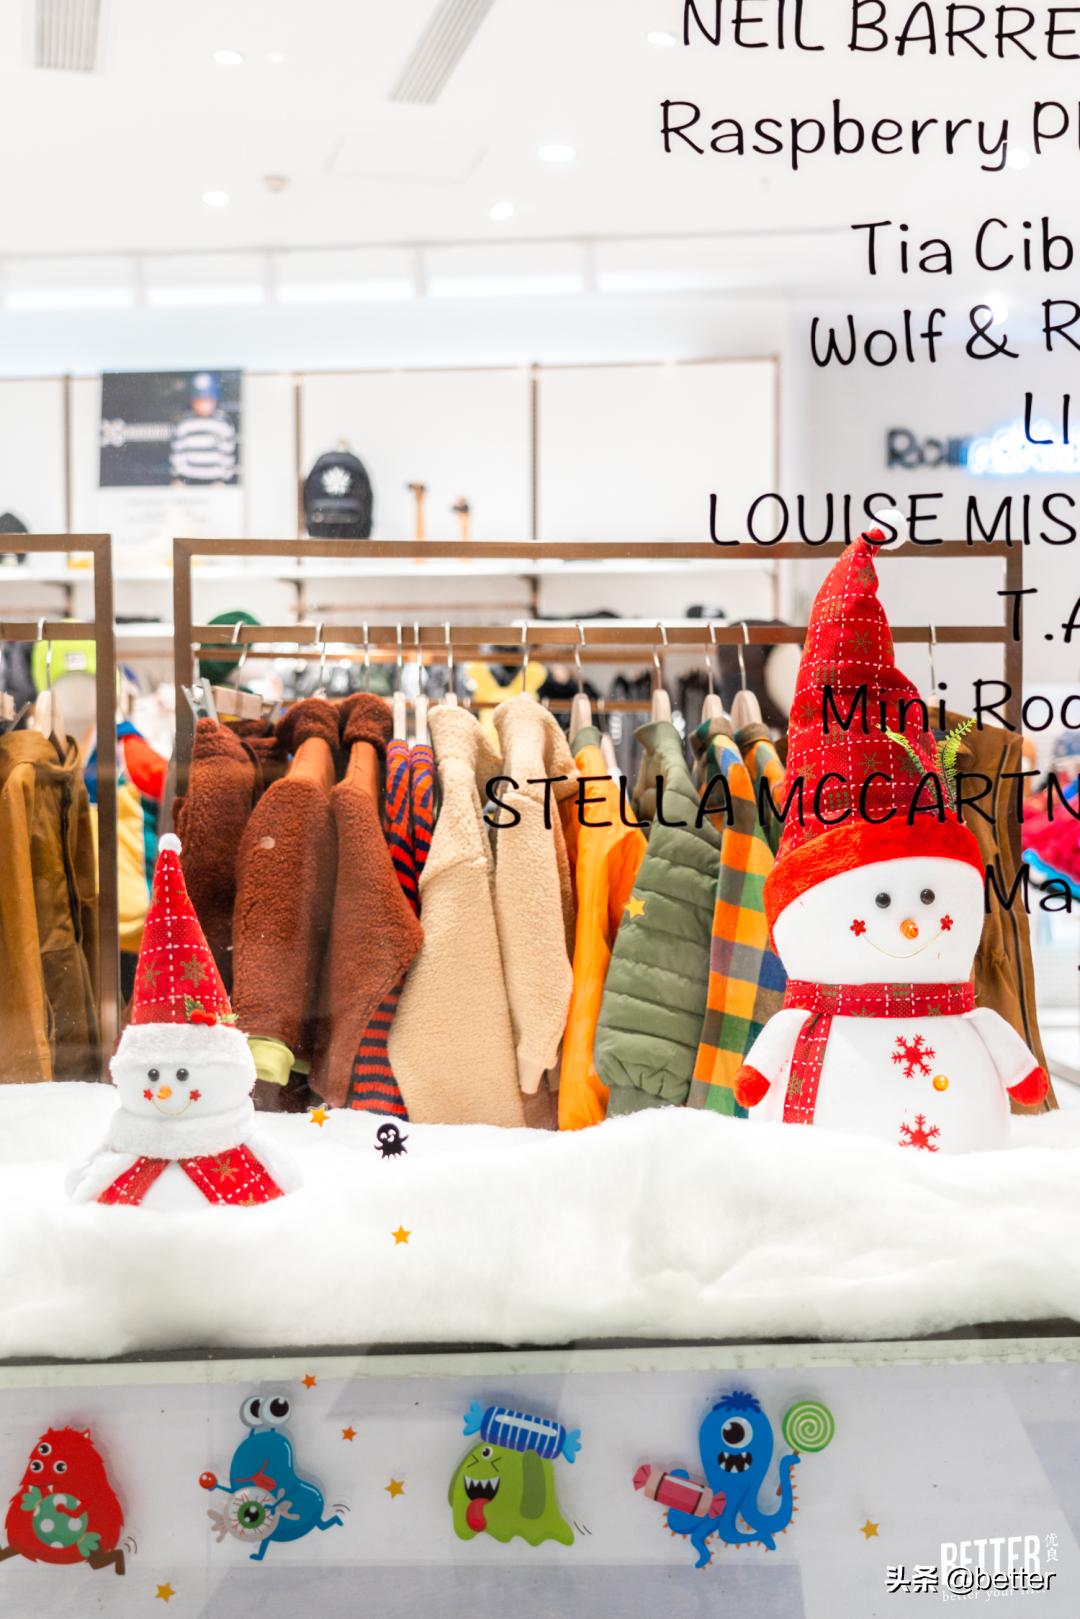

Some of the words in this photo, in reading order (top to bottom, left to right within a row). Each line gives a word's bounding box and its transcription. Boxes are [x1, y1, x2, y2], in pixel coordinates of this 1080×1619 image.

[683, 0, 825, 51] NEIL
[848, 0, 1080, 61] BARRE
[660, 99, 1009, 172] Raspberry
[1033, 101, 1080, 154] P
[851, 220, 952, 275] Tia
[975, 216, 1074, 273] Cib
[810, 308, 946, 367] Wolf
[966, 304, 1019, 360] &
[1024, 392, 1071, 445] LI
[710, 493, 944, 546] LOUISE
[966, 493, 1077, 548] MIS
[821, 680, 947, 735] Mini
[482, 774, 735, 829] STELLA
[757, 771, 1080, 826] MCCARTN
[984, 863, 1072, 914] Ma
